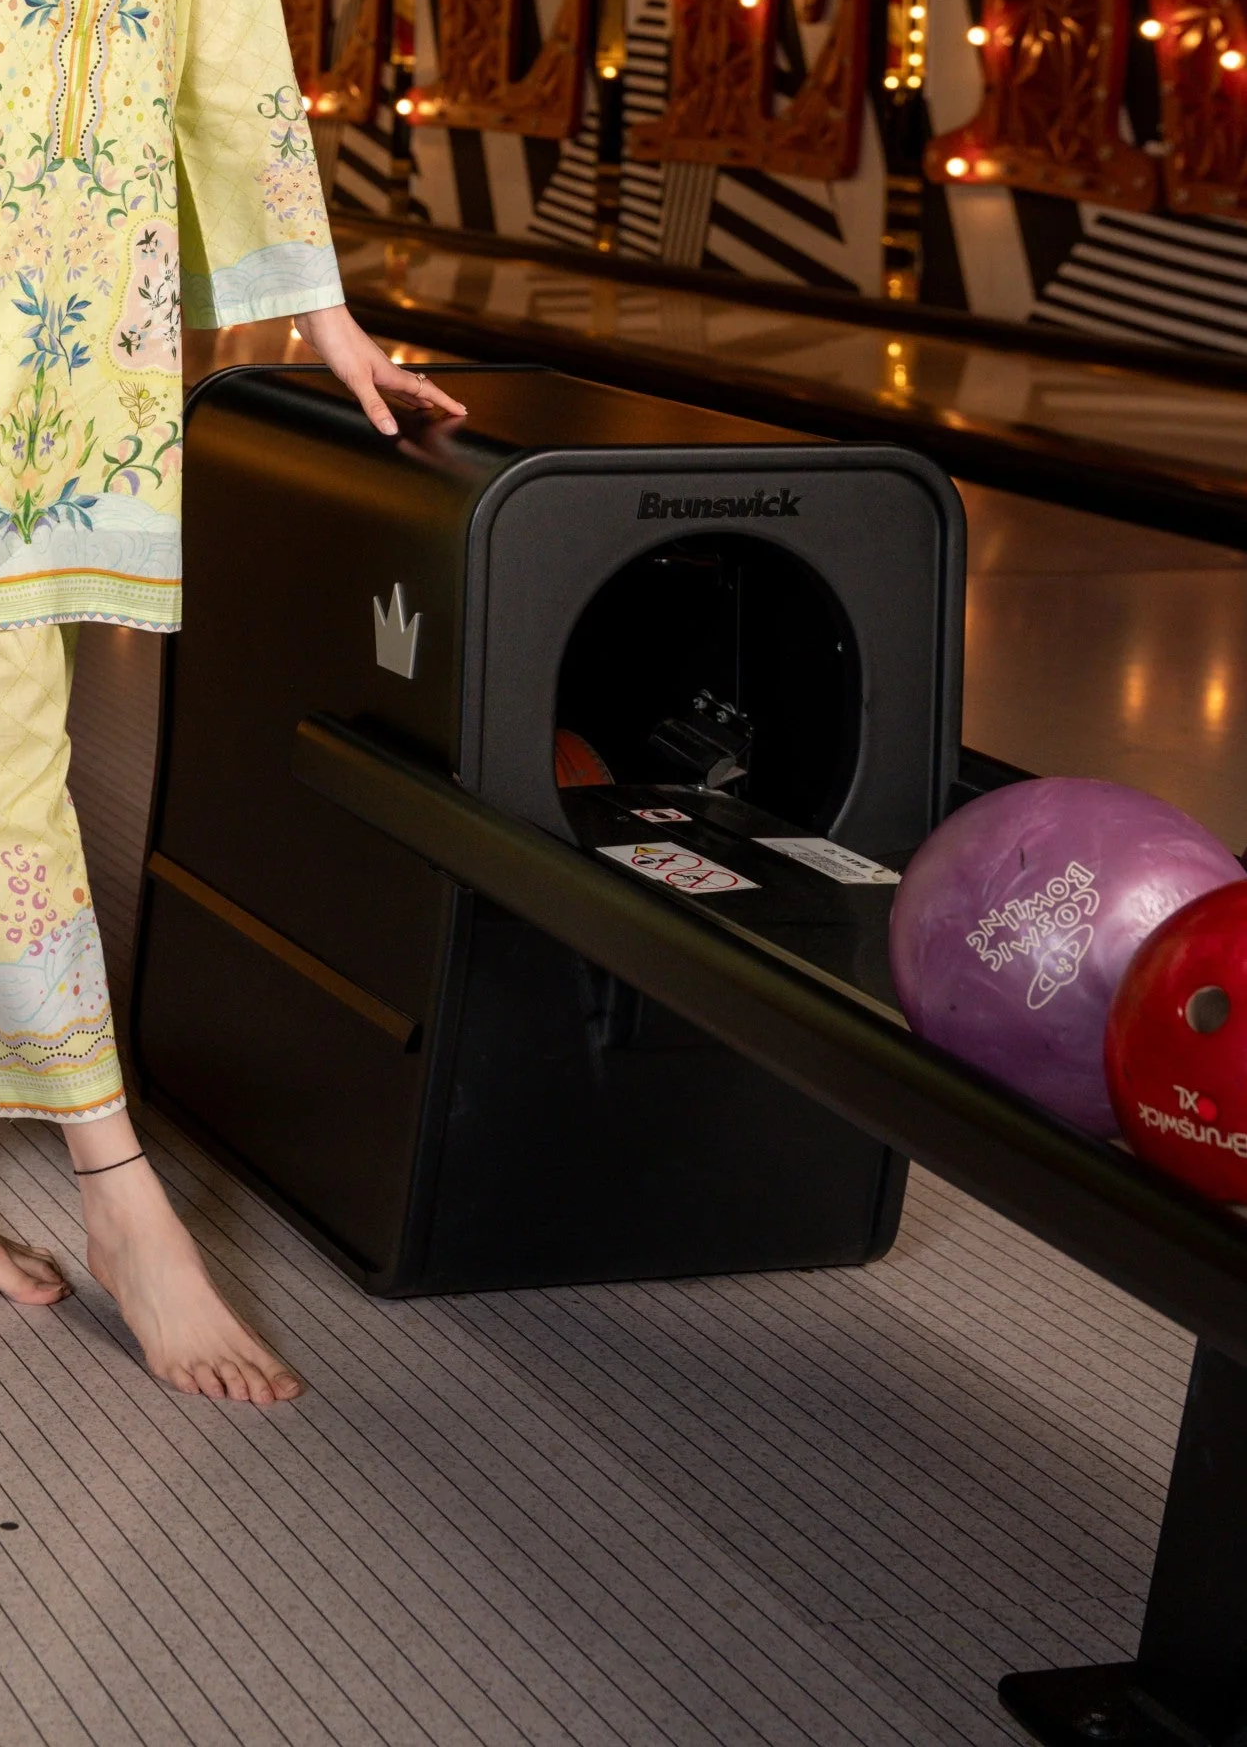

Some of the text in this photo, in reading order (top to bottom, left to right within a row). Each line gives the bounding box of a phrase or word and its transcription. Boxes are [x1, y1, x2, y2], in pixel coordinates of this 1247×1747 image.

[637, 488, 801, 519] Brunswick
[966, 861, 1094, 953] BOWLING
[980, 888, 1100, 972] COSMIC
[1172, 1084, 1199, 1114] XL
